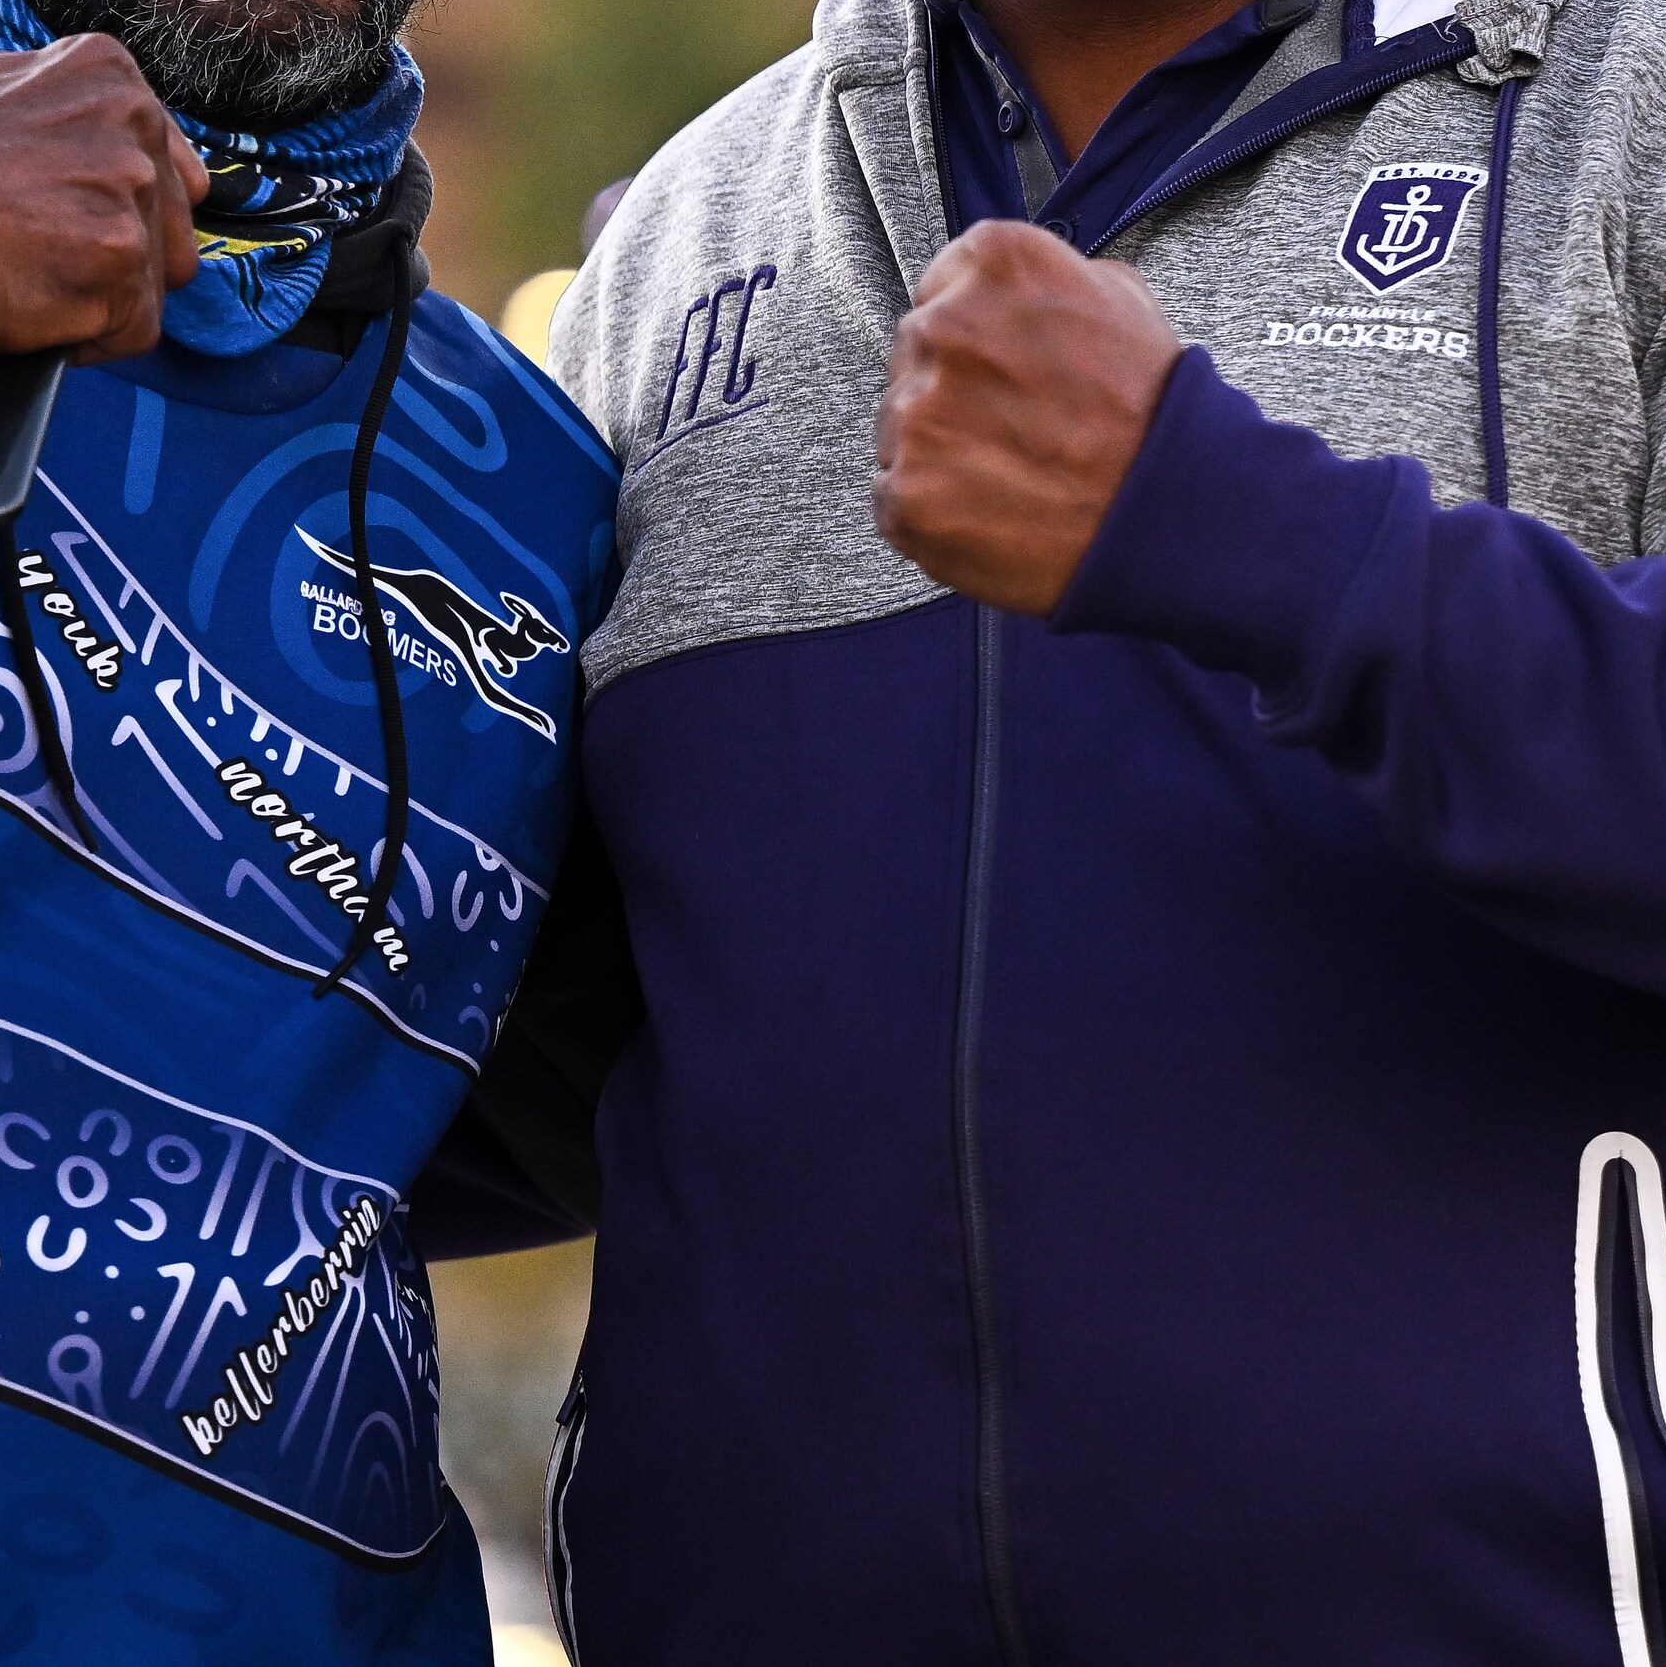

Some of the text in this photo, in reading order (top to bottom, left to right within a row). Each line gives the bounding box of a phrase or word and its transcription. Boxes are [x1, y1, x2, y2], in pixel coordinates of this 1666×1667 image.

[1376, 167, 1424, 179] EST.
[1308, 305, 1437, 322] FREMANTLE
[1261, 321, 1470, 358] DOCKERS
[182, 1199, 381, 1456] kellerberrin
